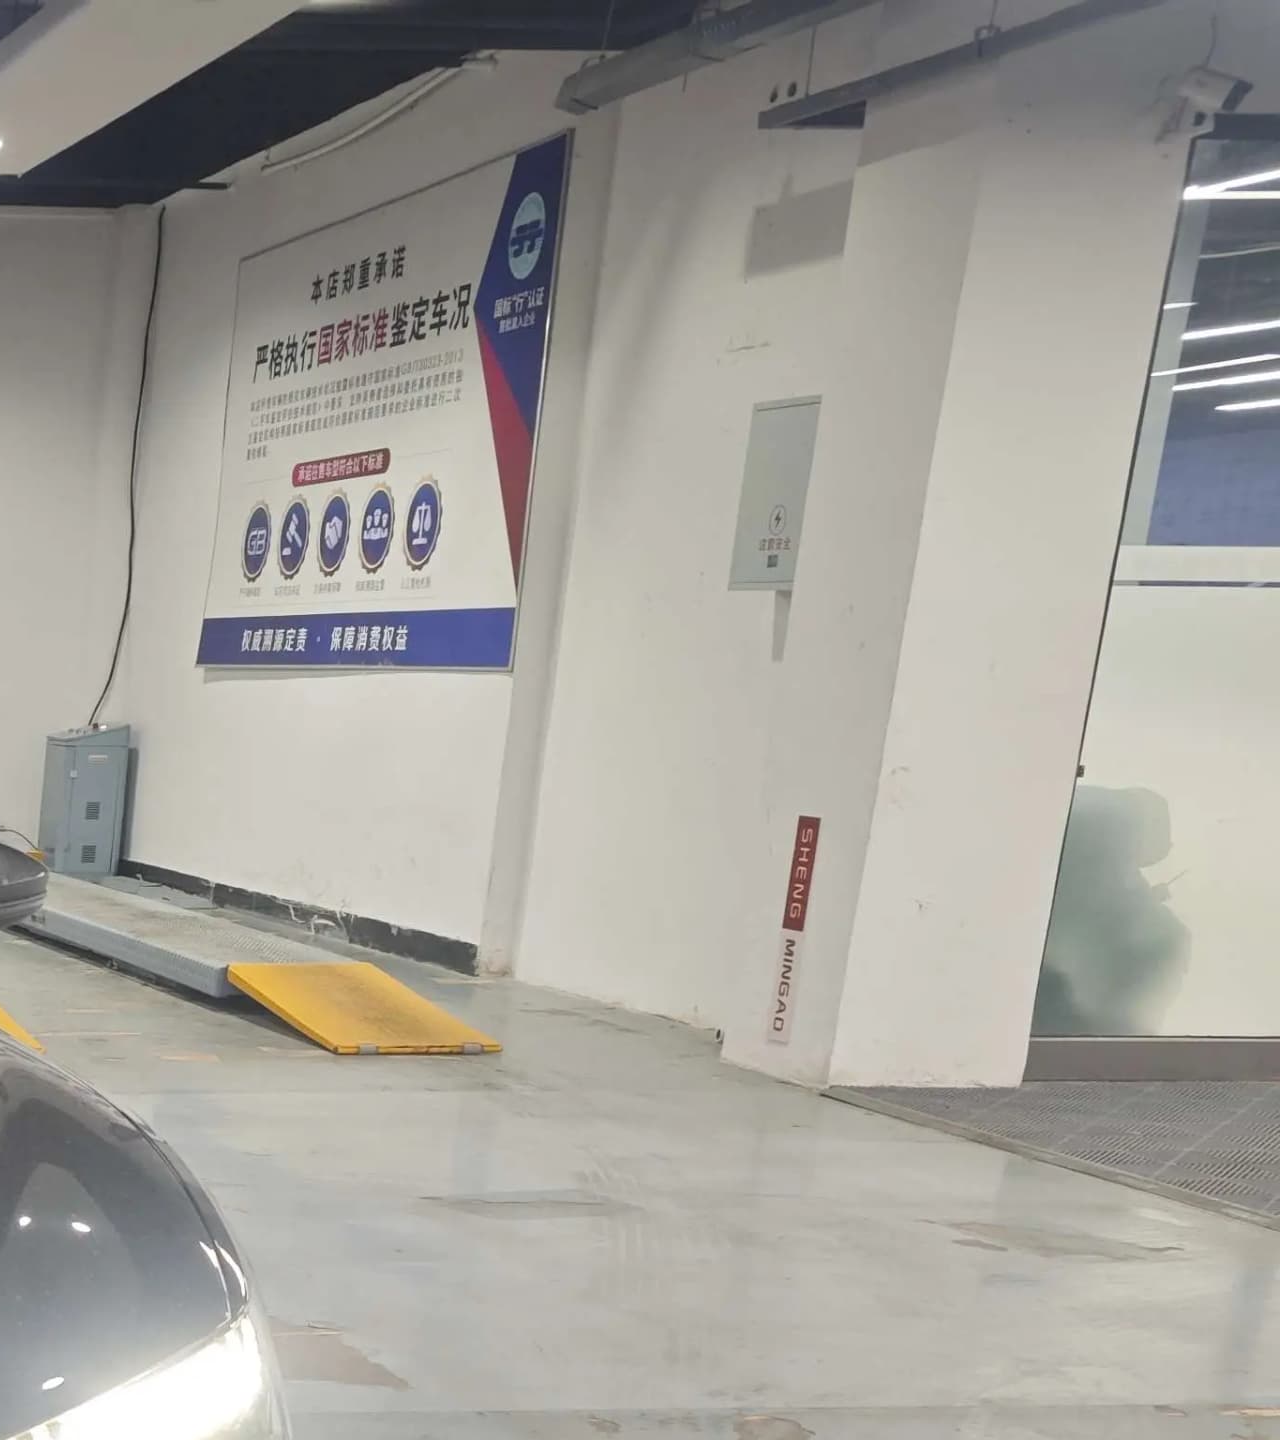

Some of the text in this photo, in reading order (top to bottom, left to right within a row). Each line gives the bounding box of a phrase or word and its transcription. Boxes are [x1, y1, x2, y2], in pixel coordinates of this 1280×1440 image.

[311, 246, 407, 304] 本店郑重承诺
[253, 283, 472, 384] 严格执行国家标准鉴定车况
[330, 625, 408, 652] 保障消费权益
[789, 827, 814, 919] SHENG
[772, 938, 796, 1032] MINGAO
